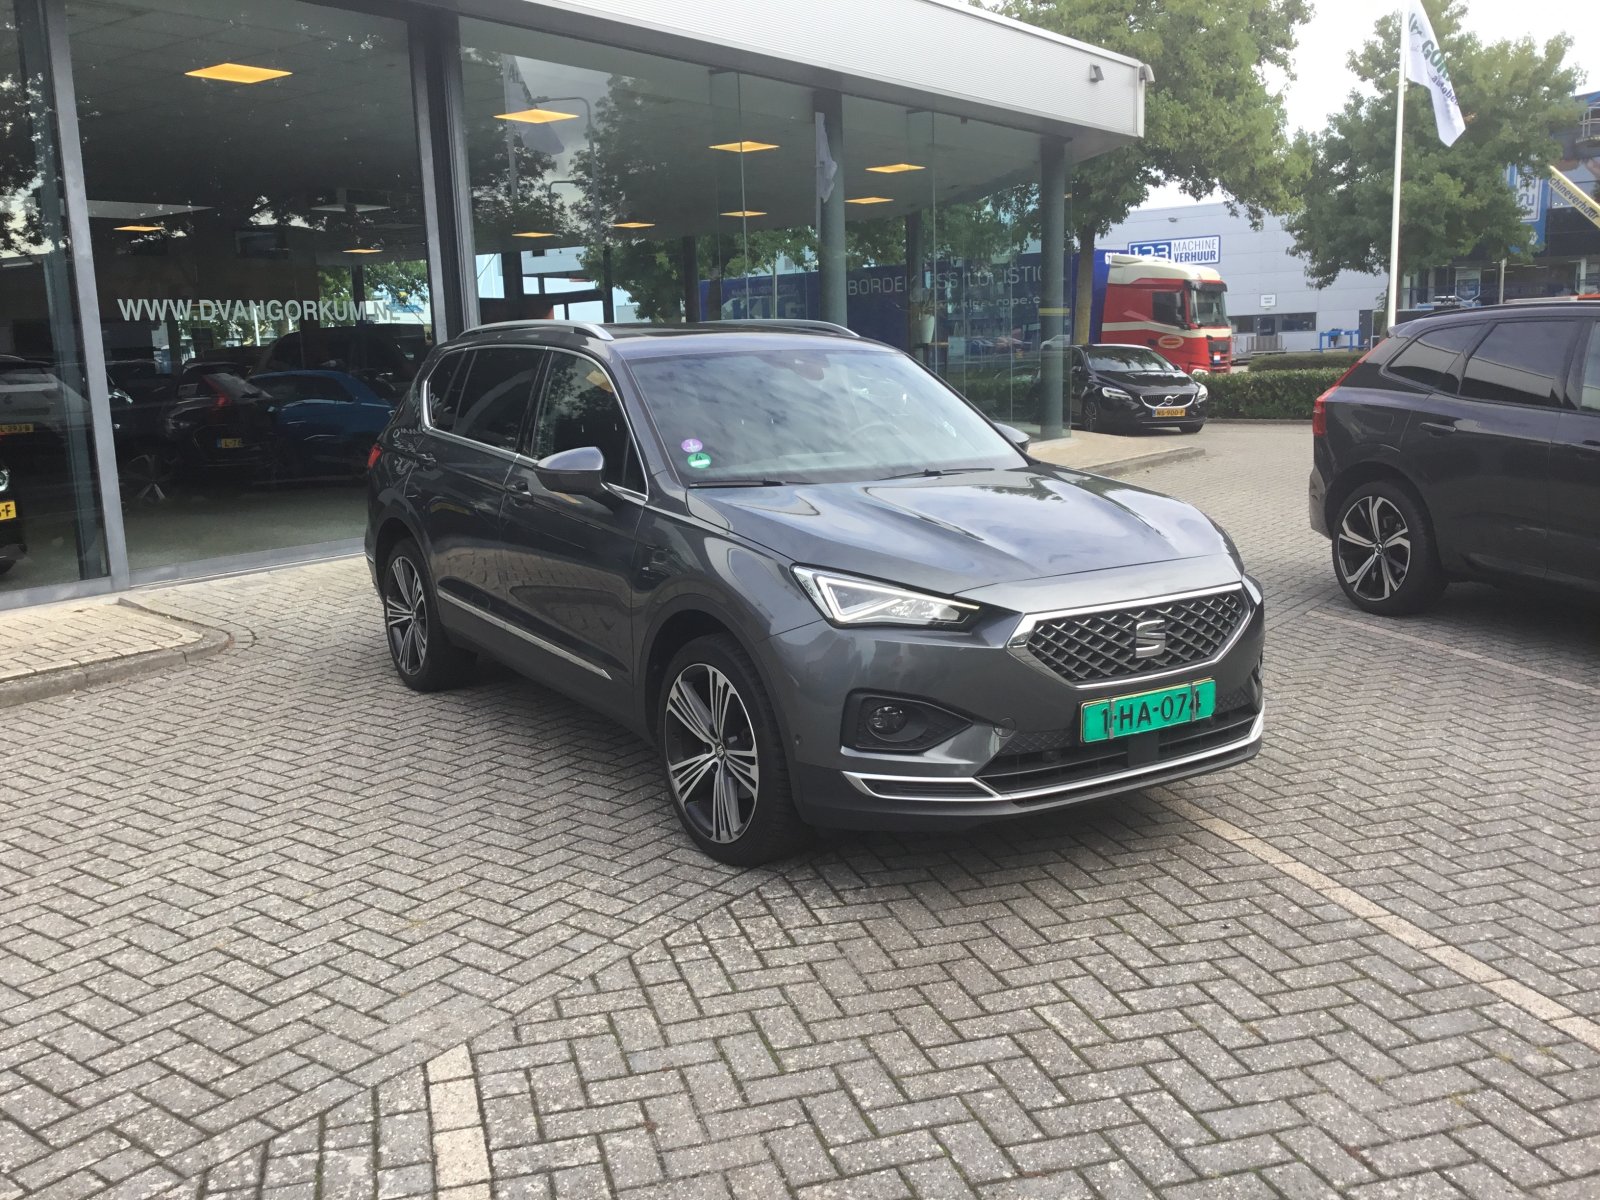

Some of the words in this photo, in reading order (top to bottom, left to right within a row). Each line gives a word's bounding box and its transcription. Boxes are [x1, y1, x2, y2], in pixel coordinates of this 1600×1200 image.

[1173, 238, 1217, 252] MACHINE
[1173, 250, 1217, 263] VERHUUR
[117, 298, 400, 321] WWW.DVANGORKUM.NL
[1101, 689, 1202, 735] 1-HA-074
